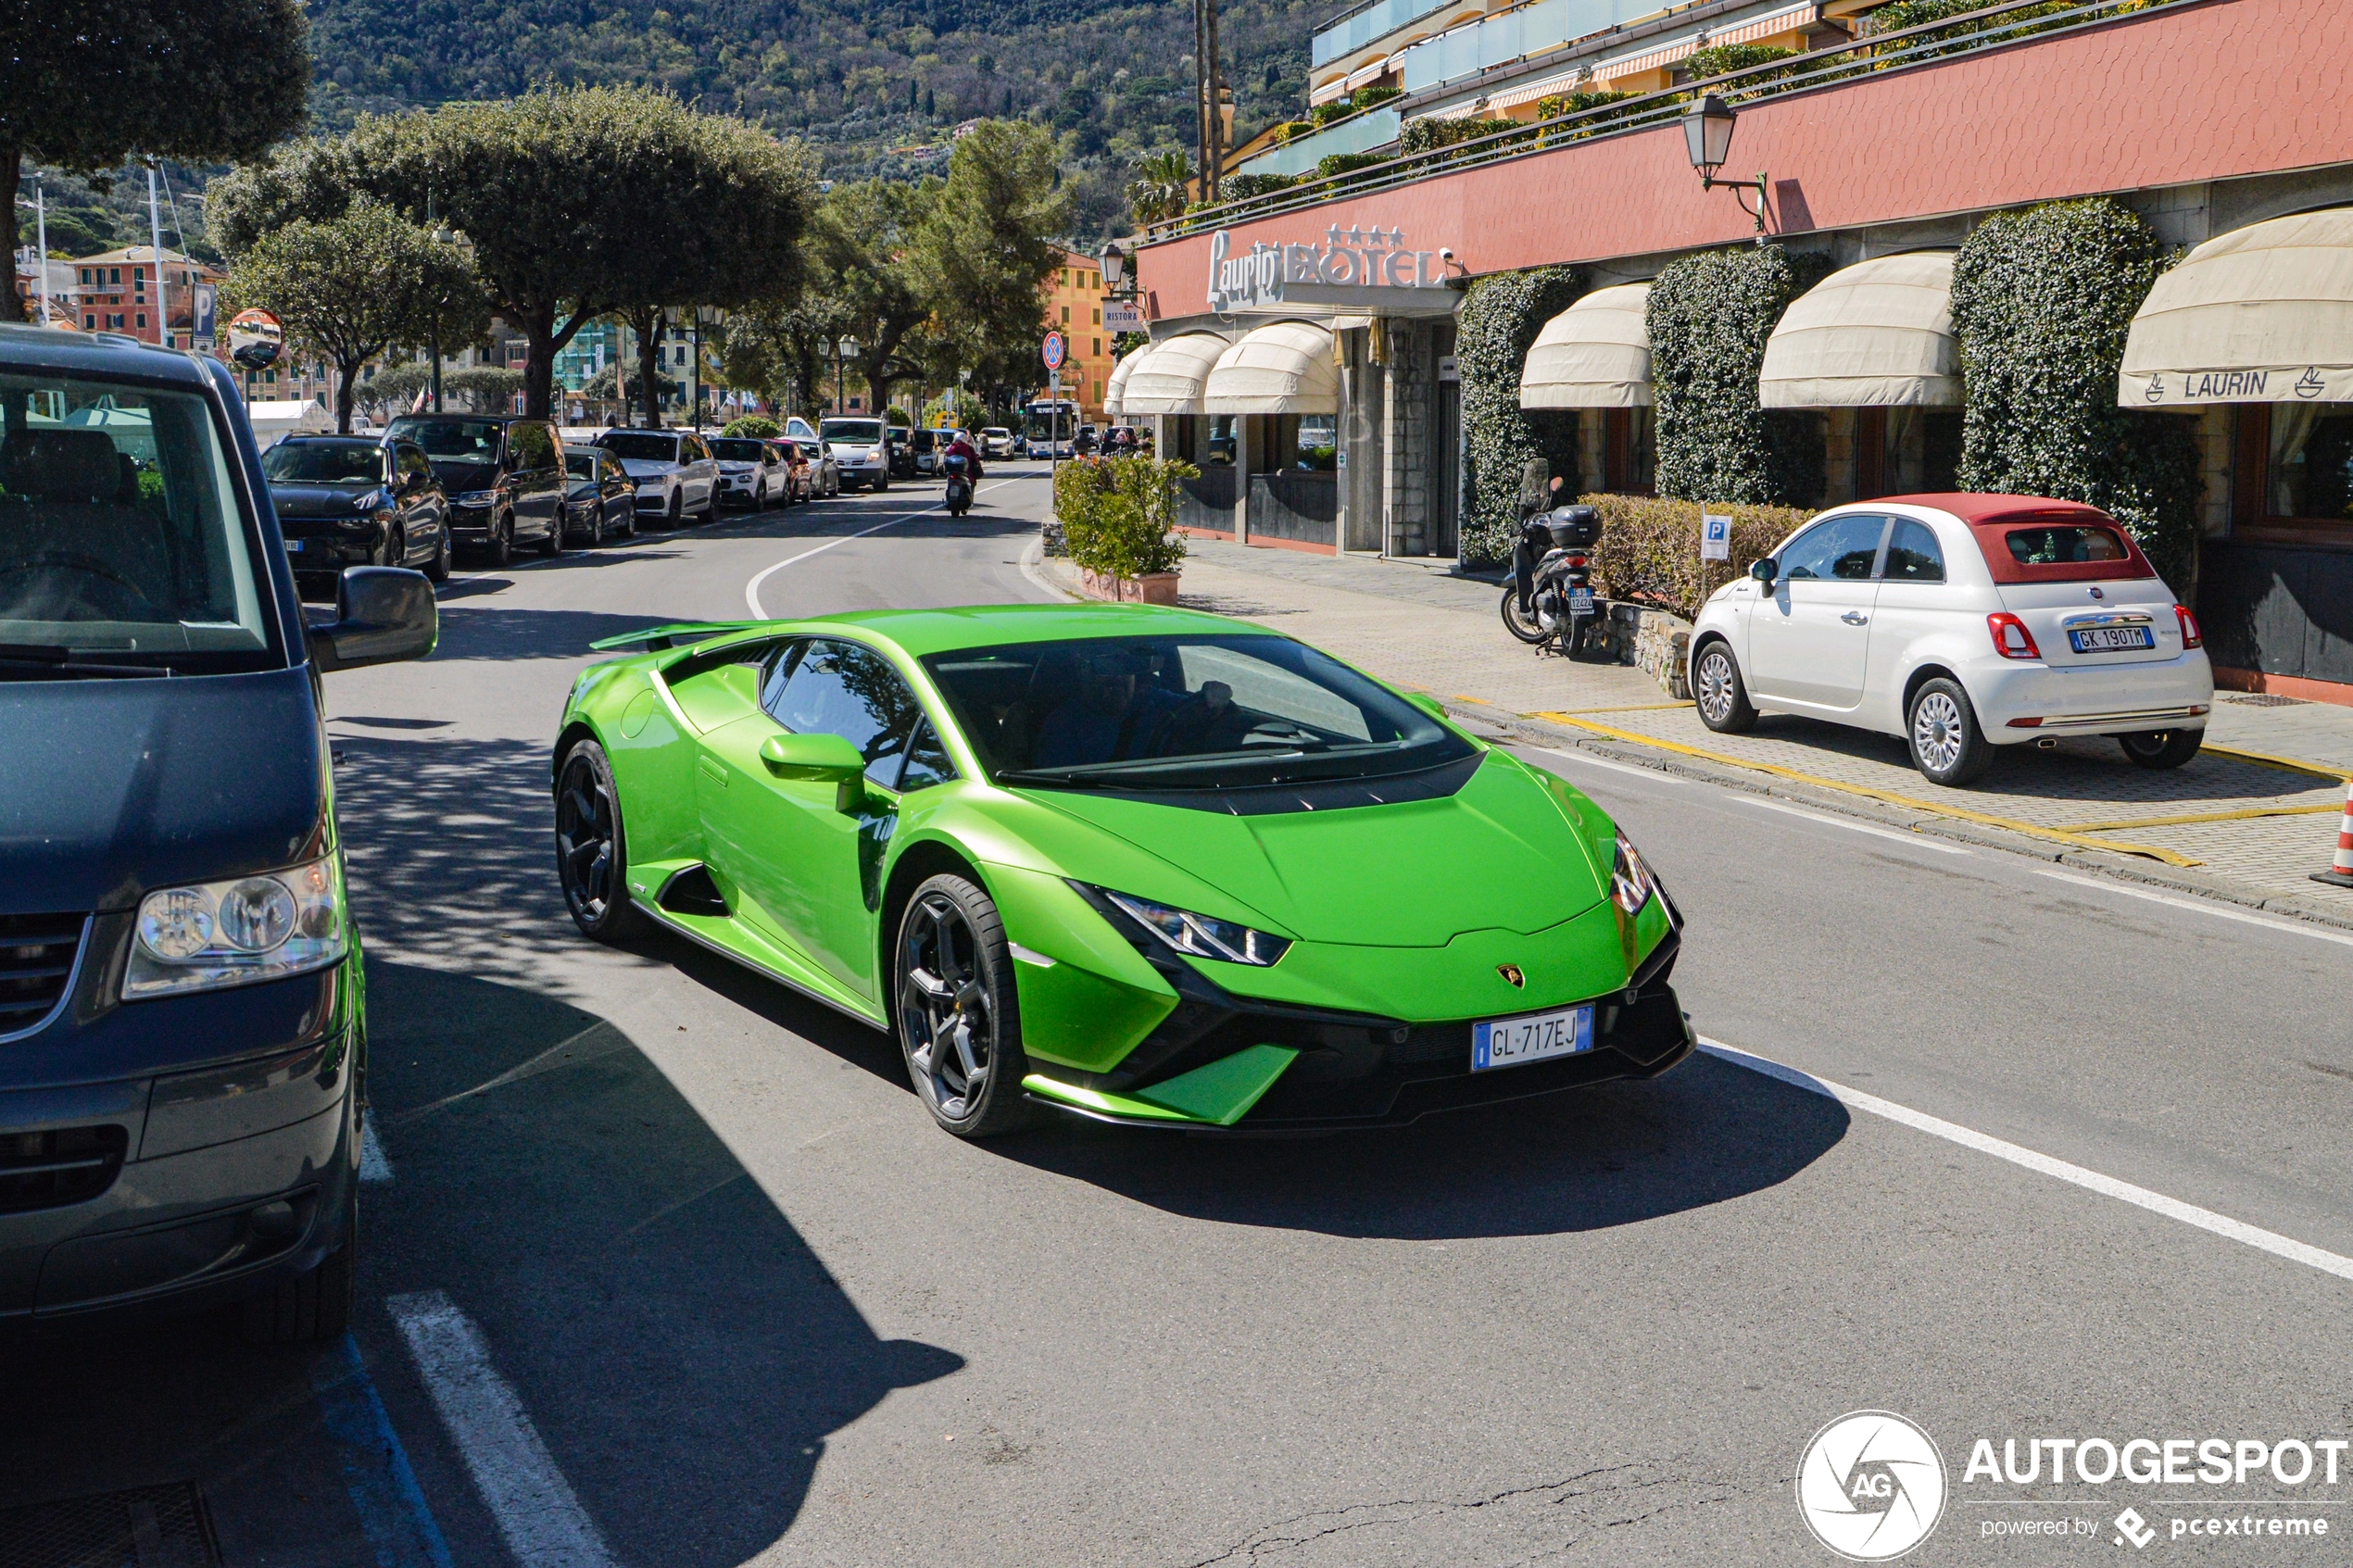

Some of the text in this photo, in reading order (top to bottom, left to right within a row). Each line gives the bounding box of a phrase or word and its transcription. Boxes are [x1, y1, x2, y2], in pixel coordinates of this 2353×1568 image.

[1207, 230, 1280, 304] Laurin
[197, 289, 211, 332] P
[1107, 312, 1138, 320] RISTORA
[2184, 370, 2269, 398] LAURIN
[1711, 523, 1721, 539] P
[1572, 598, 1592, 608] 12424
[2080, 629, 2145, 646] GK 190TM
[1492, 1017, 1577, 1057] GL 717EJ
